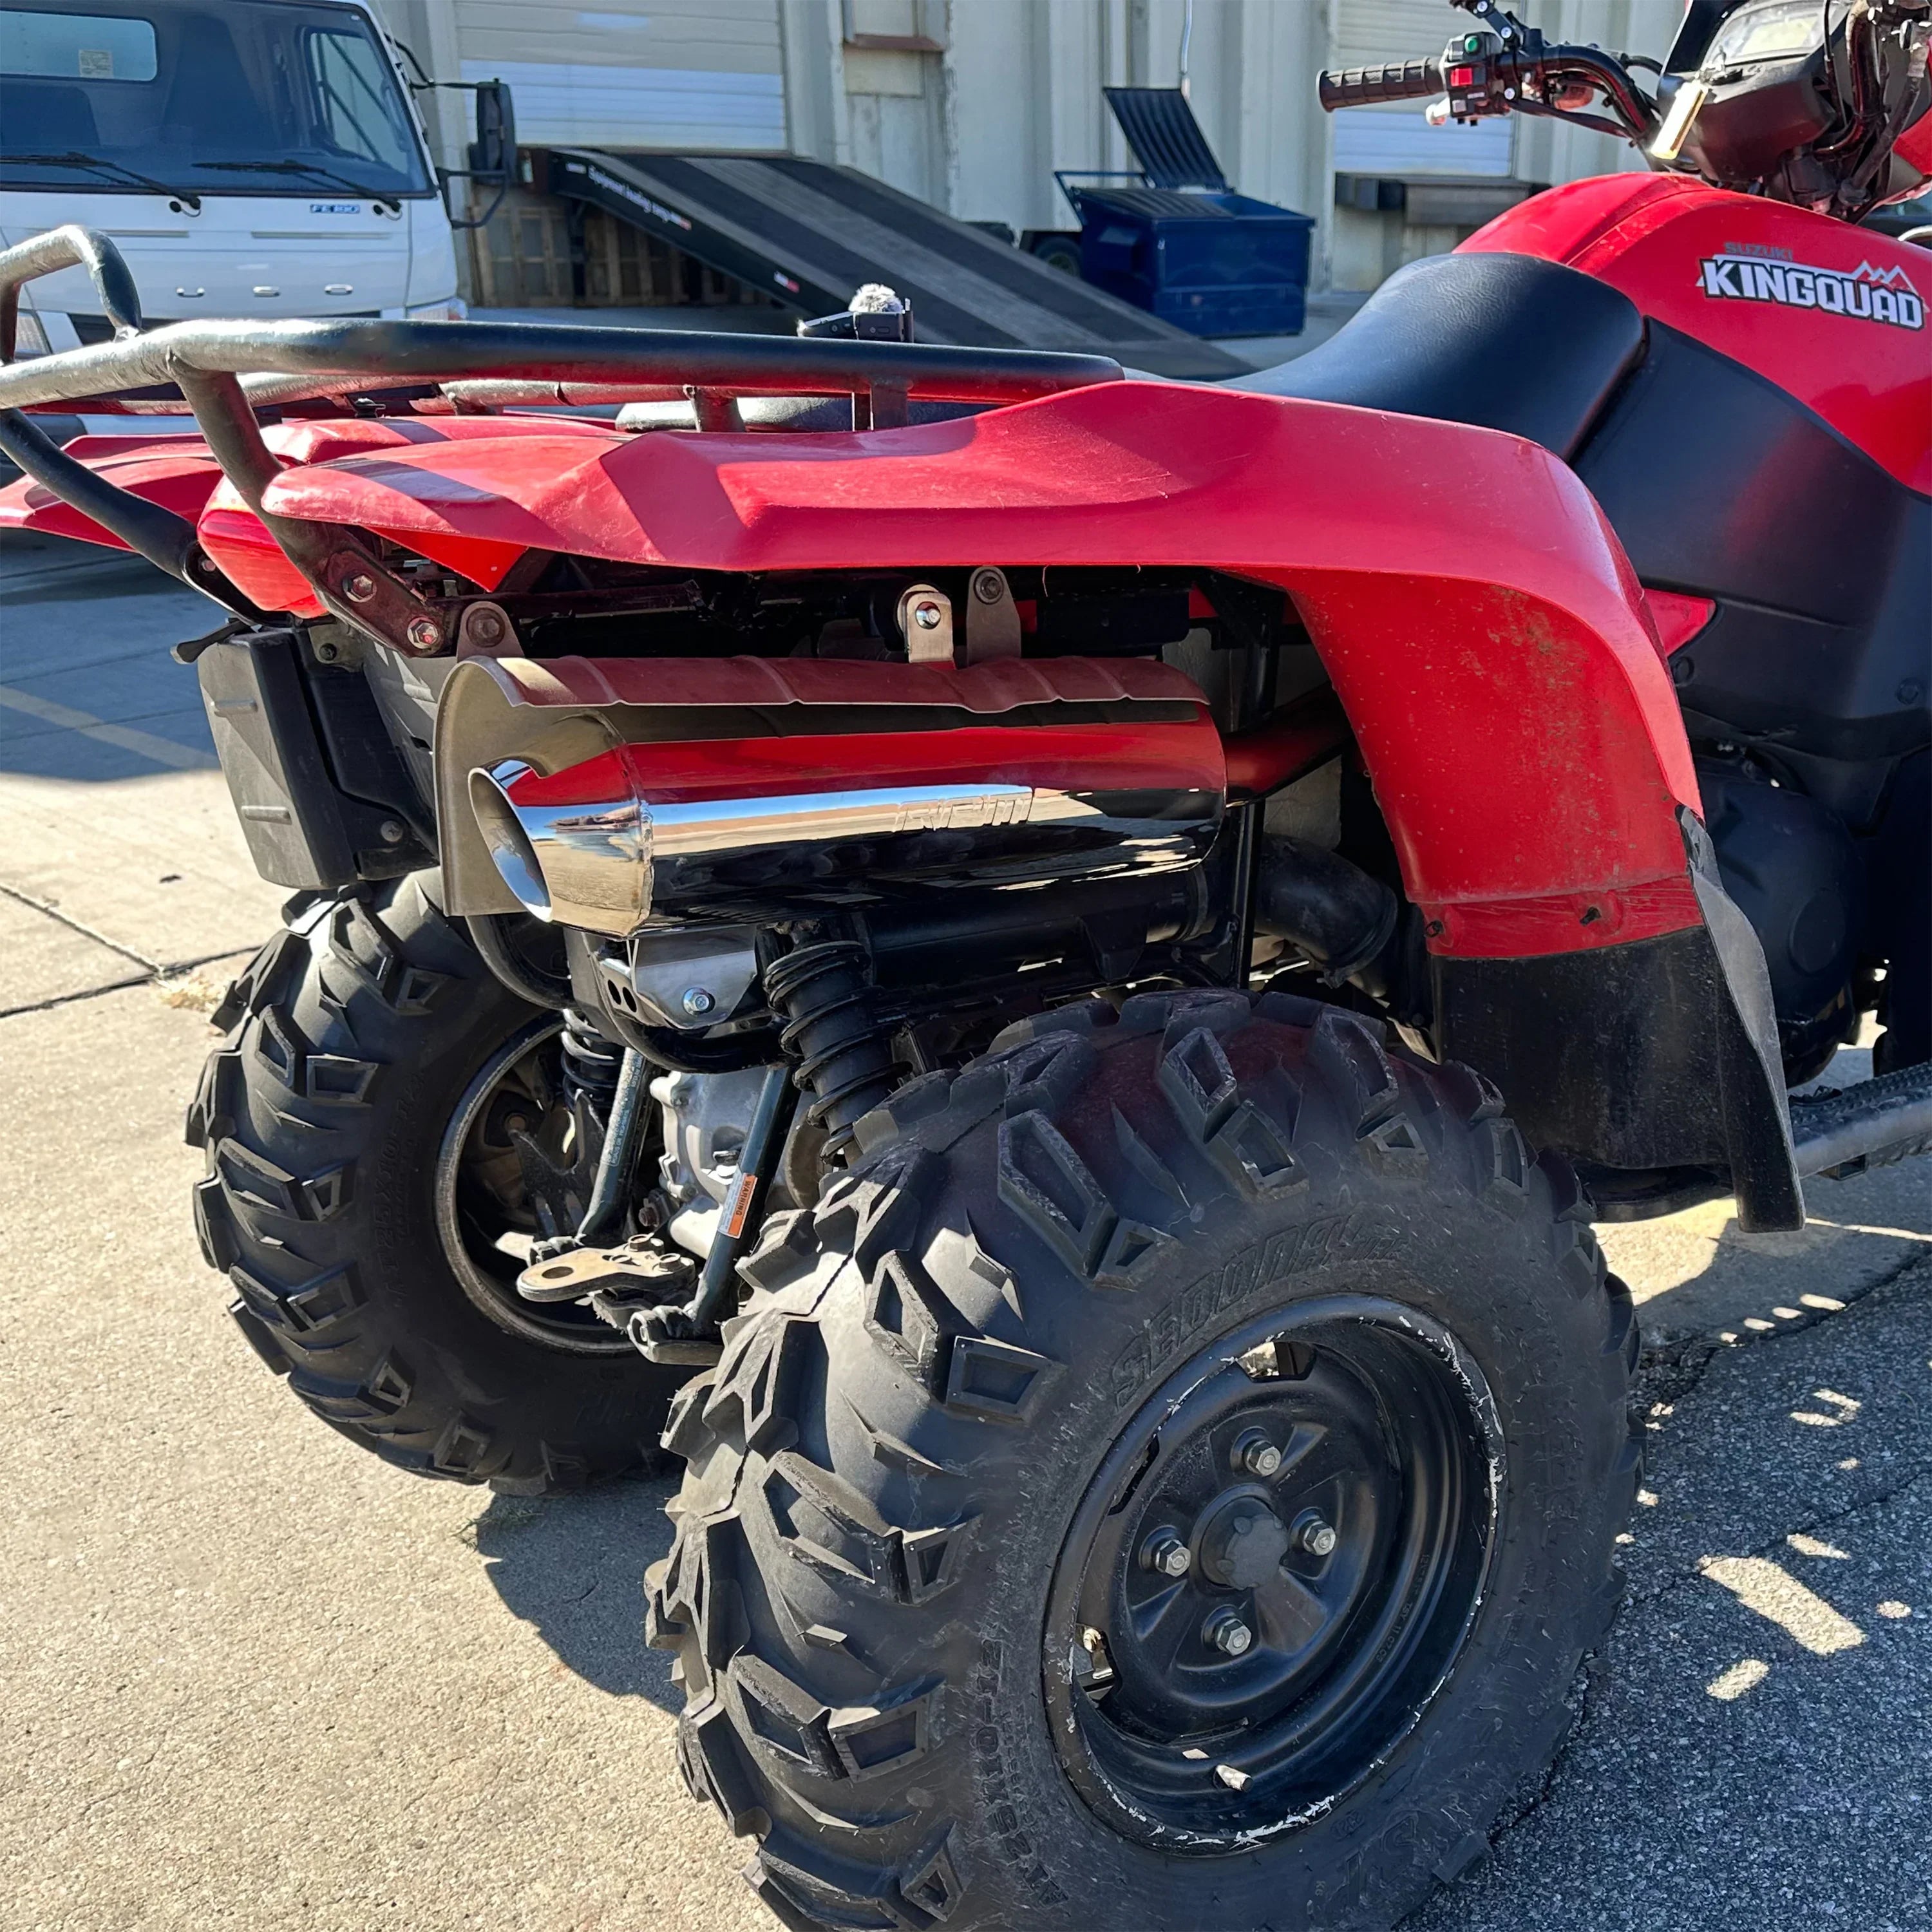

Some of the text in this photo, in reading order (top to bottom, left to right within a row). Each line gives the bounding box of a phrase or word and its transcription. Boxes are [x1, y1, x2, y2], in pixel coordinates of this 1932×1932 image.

[1723, 241, 1794, 262] SUZUKI
[1700, 258, 1925, 331] KINGQUAD
[735, 1179, 752, 1216] WARNING
